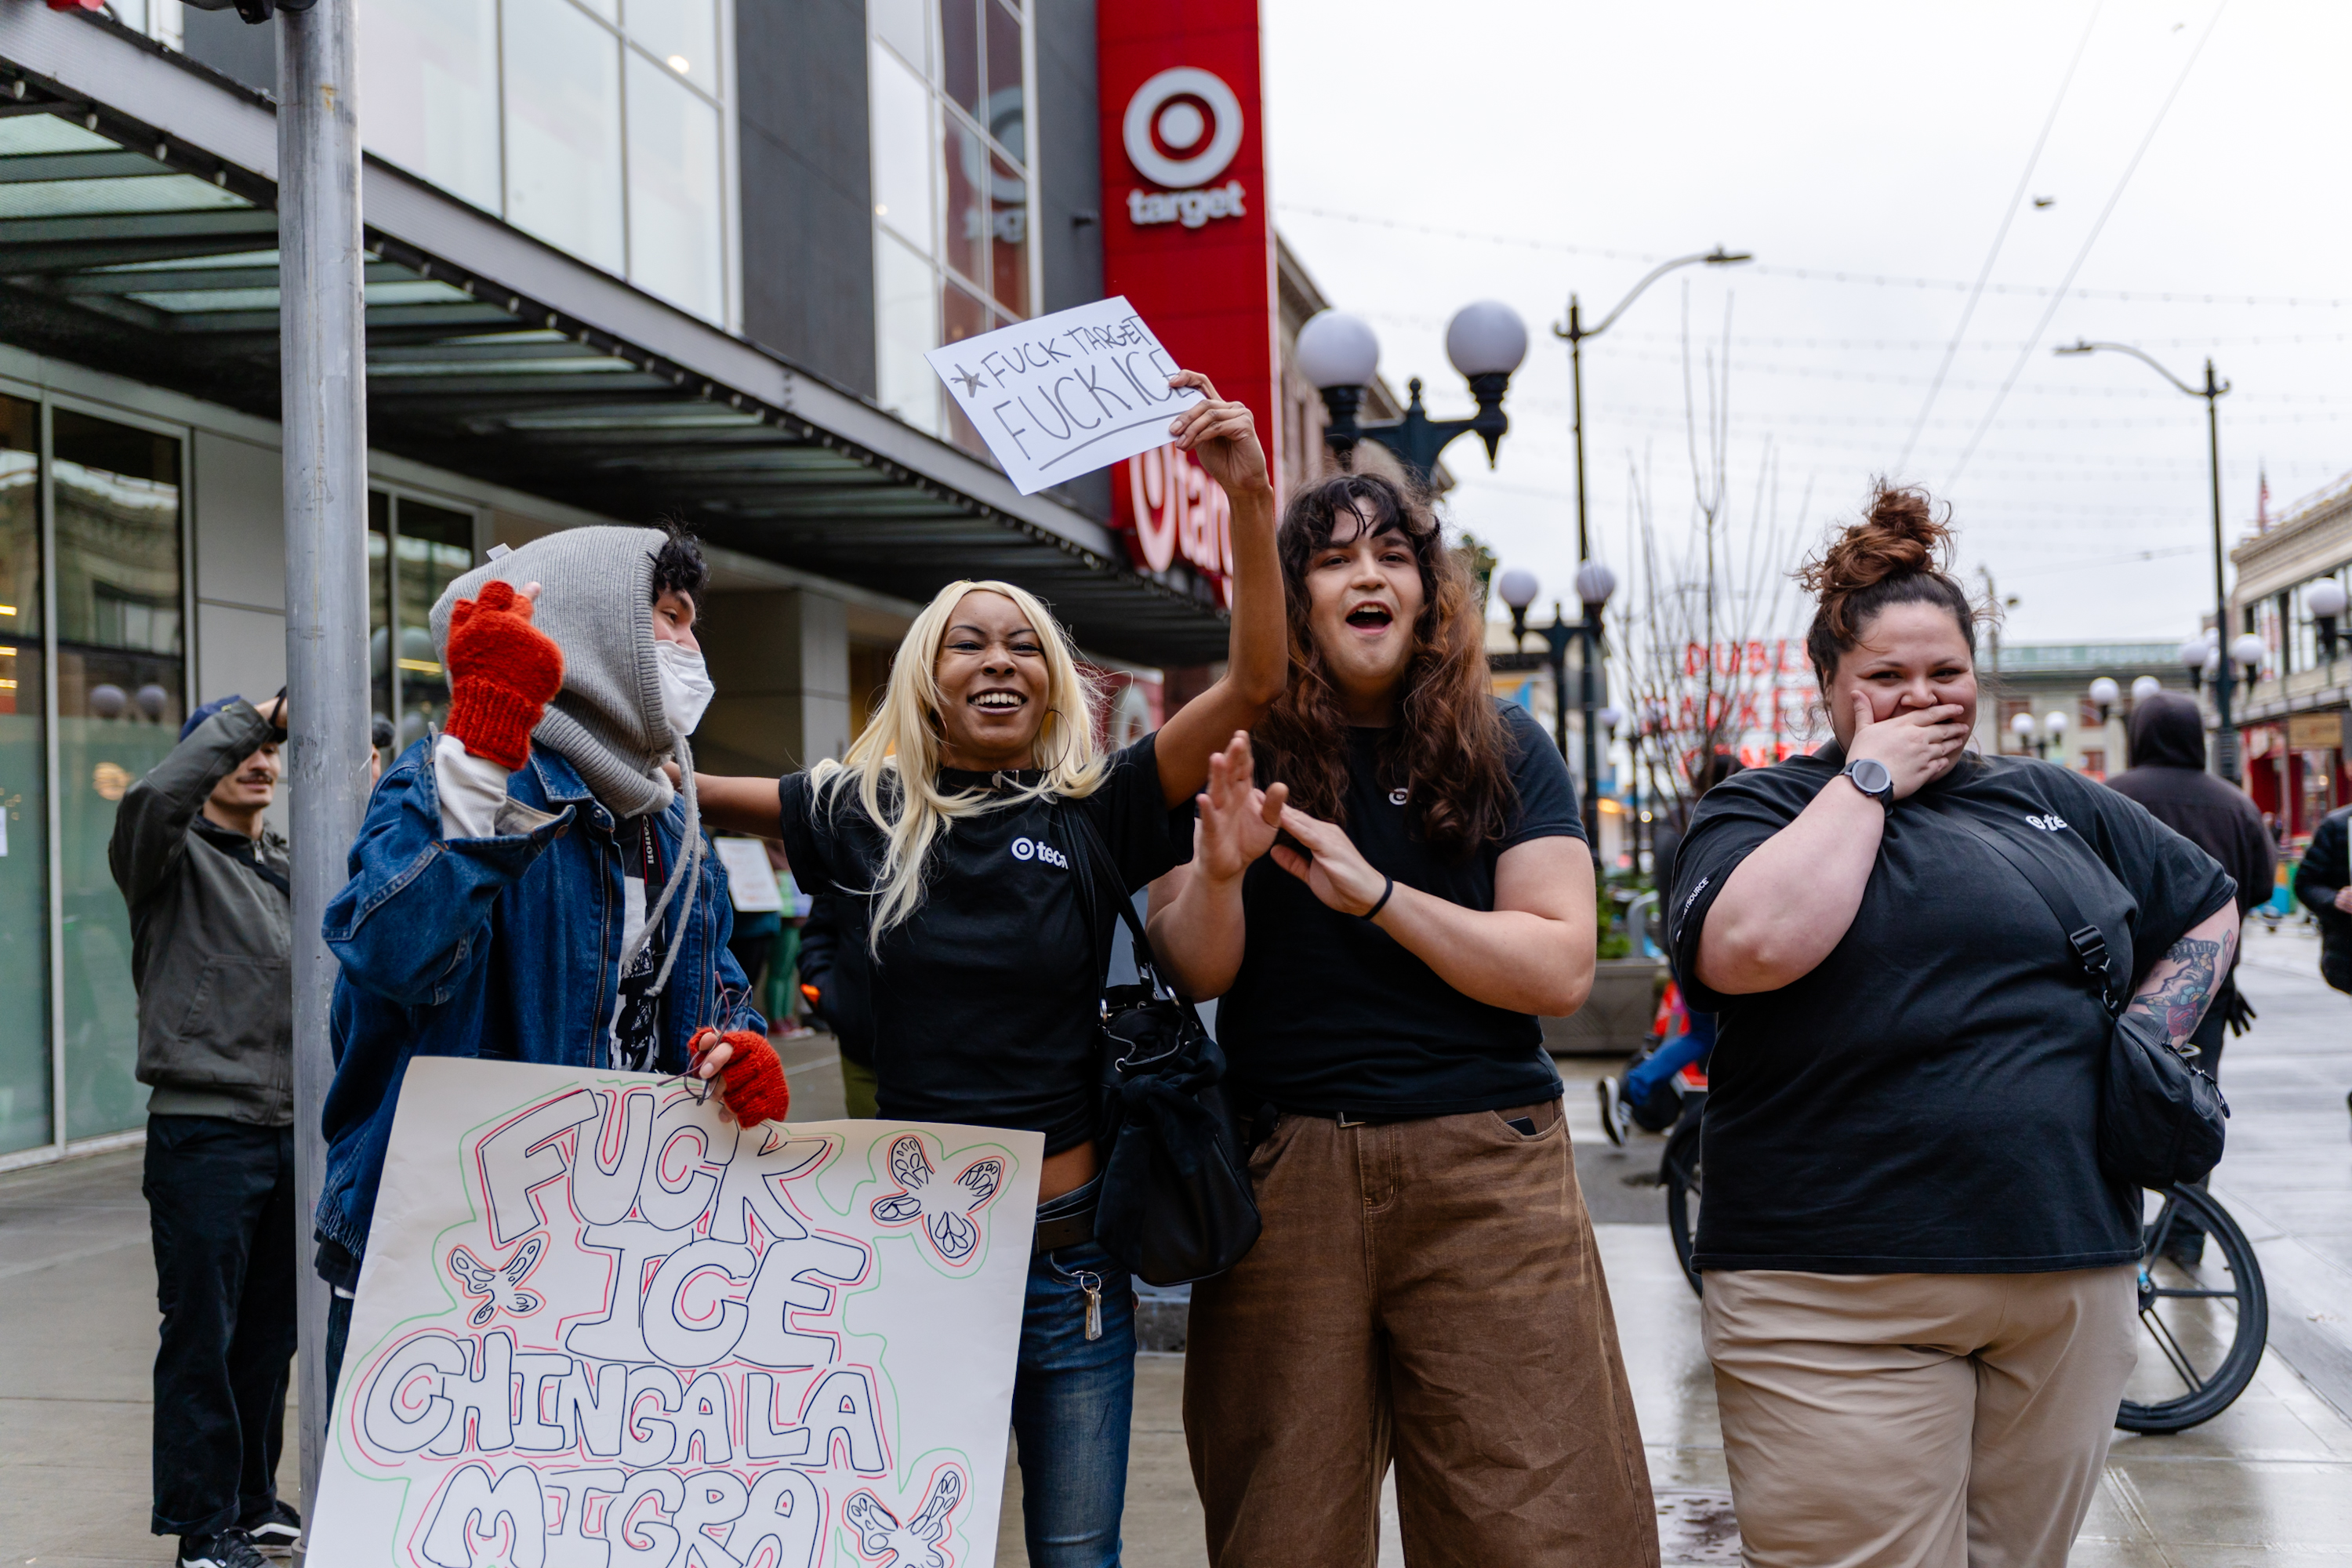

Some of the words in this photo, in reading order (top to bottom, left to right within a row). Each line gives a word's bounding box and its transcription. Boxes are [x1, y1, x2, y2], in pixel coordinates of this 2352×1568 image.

[1127, 180, 1247, 229] target
[981, 338, 1071, 388] FUCK
[1063, 315, 1152, 355] TARGET
[993, 365, 1133, 460] FUCK
[1111, 348, 1197, 406] ICE
[1175, 447, 1233, 612] tar
[643, 815, 655, 864] Canon
[480, 1088, 827, 1245] FUCK
[565, 1225, 866, 1369] ICE
[422, 1465, 821, 1568] MIGRA
